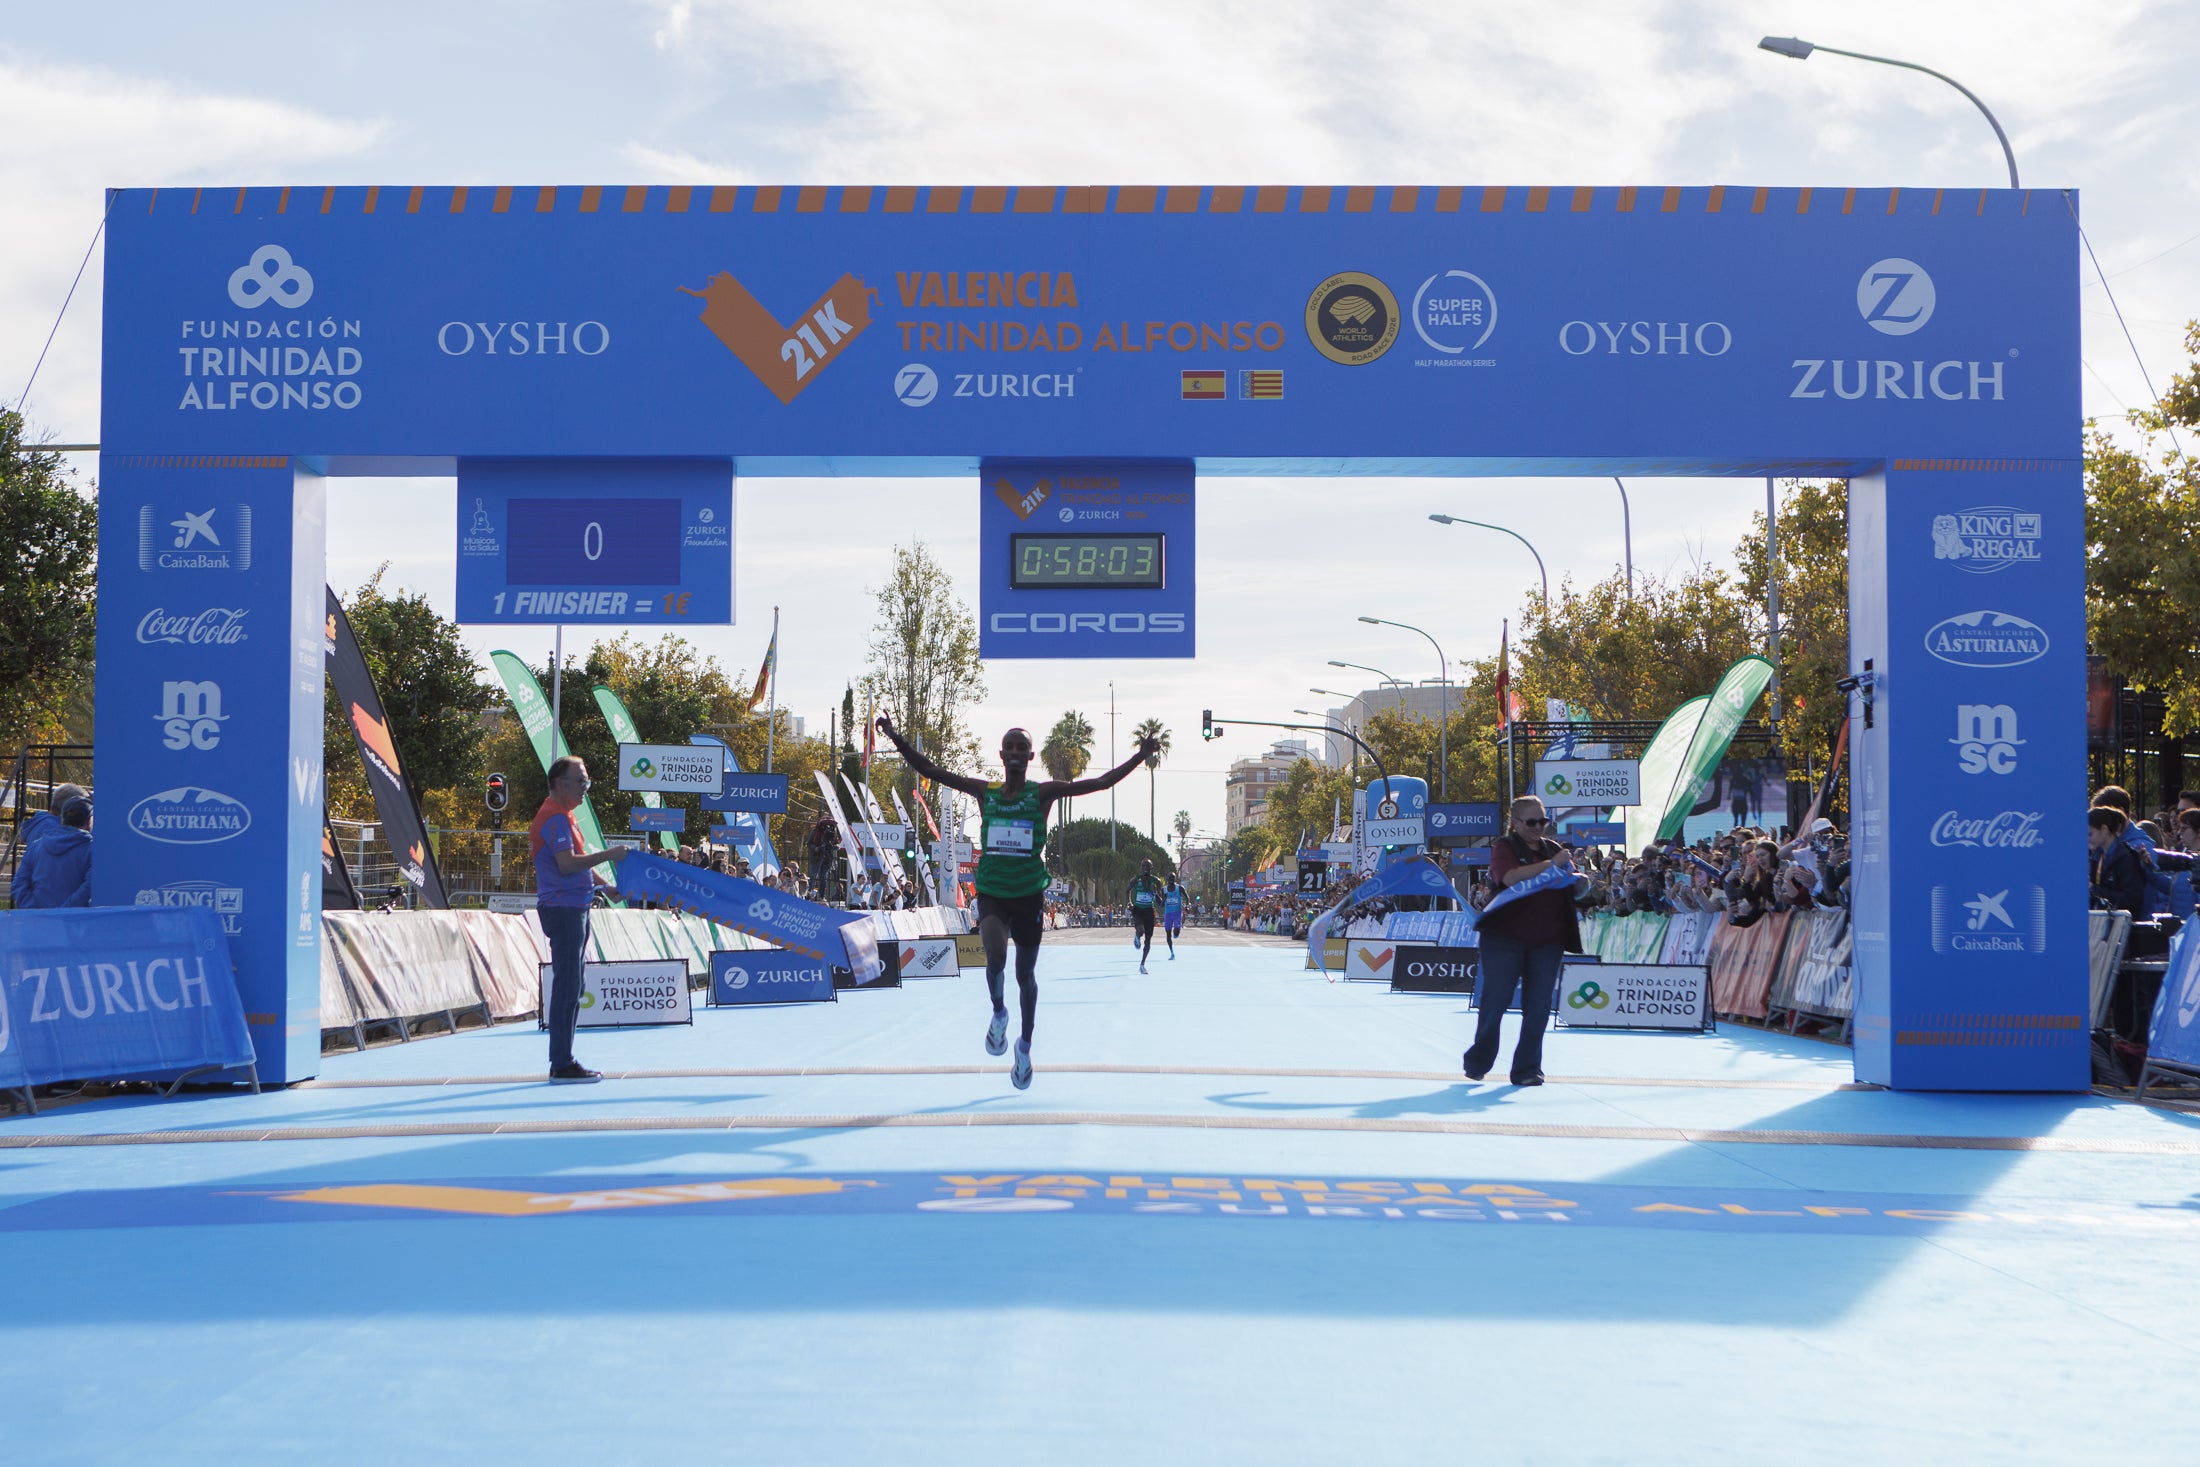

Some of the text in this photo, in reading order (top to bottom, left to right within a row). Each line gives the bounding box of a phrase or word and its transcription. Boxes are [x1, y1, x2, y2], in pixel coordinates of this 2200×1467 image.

[896, 271, 1078, 307] VALENCIA
[1310, 277, 1345, 311] GOLD LABEL
[1428, 299, 1482, 311] SUPER
[182, 316, 361, 338] FUNDACIÓN
[1428, 314, 1482, 326] HALFS
[437, 321, 610, 355] OYSHO
[781, 299, 853, 381] 21K
[897, 320, 1286, 352] TRINIDAD ALFONSO
[1559, 320, 1732, 356] OYSHO
[1351, 351, 1373, 362] ROAD
[1372, 337, 1390, 355] RACE
[179, 347, 362, 376] TRINIDAD
[1473, 359, 1497, 367] SERIES
[953, 373, 1075, 399] ZURICH
[1790, 360, 2004, 401] ZURICH
[179, 381, 362, 410] ALFONSO
[1059, 477, 1120, 490] VALENCIA
[1021, 487, 1046, 514] 21K
[1060, 493, 1190, 505] TRINIDAD ALFONSO
[1078, 510, 1120, 520] ZURICH
[687, 526, 726, 535] ZURICH
[1959, 516, 2012, 536] KING
[584, 522, 603, 560] 0
[684, 536, 728, 547] Foundation
[1972, 539, 2042, 560] REGAL
[159, 553, 230, 569] CaixaBank
[1022, 546, 1153, 576] 0:58:03
[494, 592, 506, 614] 1
[514, 592, 628, 614] FINISHER
[662, 592, 692, 614] 1€
[136, 607, 249, 645] Coca-Cola
[991, 613, 1185, 633] COROS
[1934, 635, 2040, 654] ASTURIANA
[662, 756, 713, 764] FUNDACIÓN
[661, 764, 713, 774] TRINIDAD
[661, 772, 712, 784] ALFONSO
[1576, 778, 1628, 788] TRINIDAD
[730, 787, 779, 799] ZURICH
[1576, 788, 1629, 797] ALFONSO
[138, 811, 242, 830] ASTURIANA
[1451, 815, 1492, 824] ZURICH
[944, 803, 954, 872] CaixaBank
[1371, 826, 1417, 838] OYSHO
[1930, 810, 2045, 848] Coca-Cola
[996, 840, 1022, 848] KWIZERA
[646, 866, 716, 899] OYSHO
[1303, 872, 1323, 888] 21
[772, 919, 818, 940] ALFONSO
[776, 910, 822, 932] TRINIDAD
[1952, 936, 2024, 952] CaixaBank
[1323, 949, 1345, 957] UPER
[600, 975, 676, 985] FUNDACIÓN
[757, 970, 823, 984] ZURICH
[1618, 977, 1698, 988] FUNDACIÓN
[21, 957, 213, 1024] ZURICH
[600, 986, 677, 999] TRINIDAD
[1616, 988, 1697, 1002] TRINIDAD
[602, 999, 678, 1012] ALFONSO
[1615, 1002, 1696, 1016] ALFONSO
